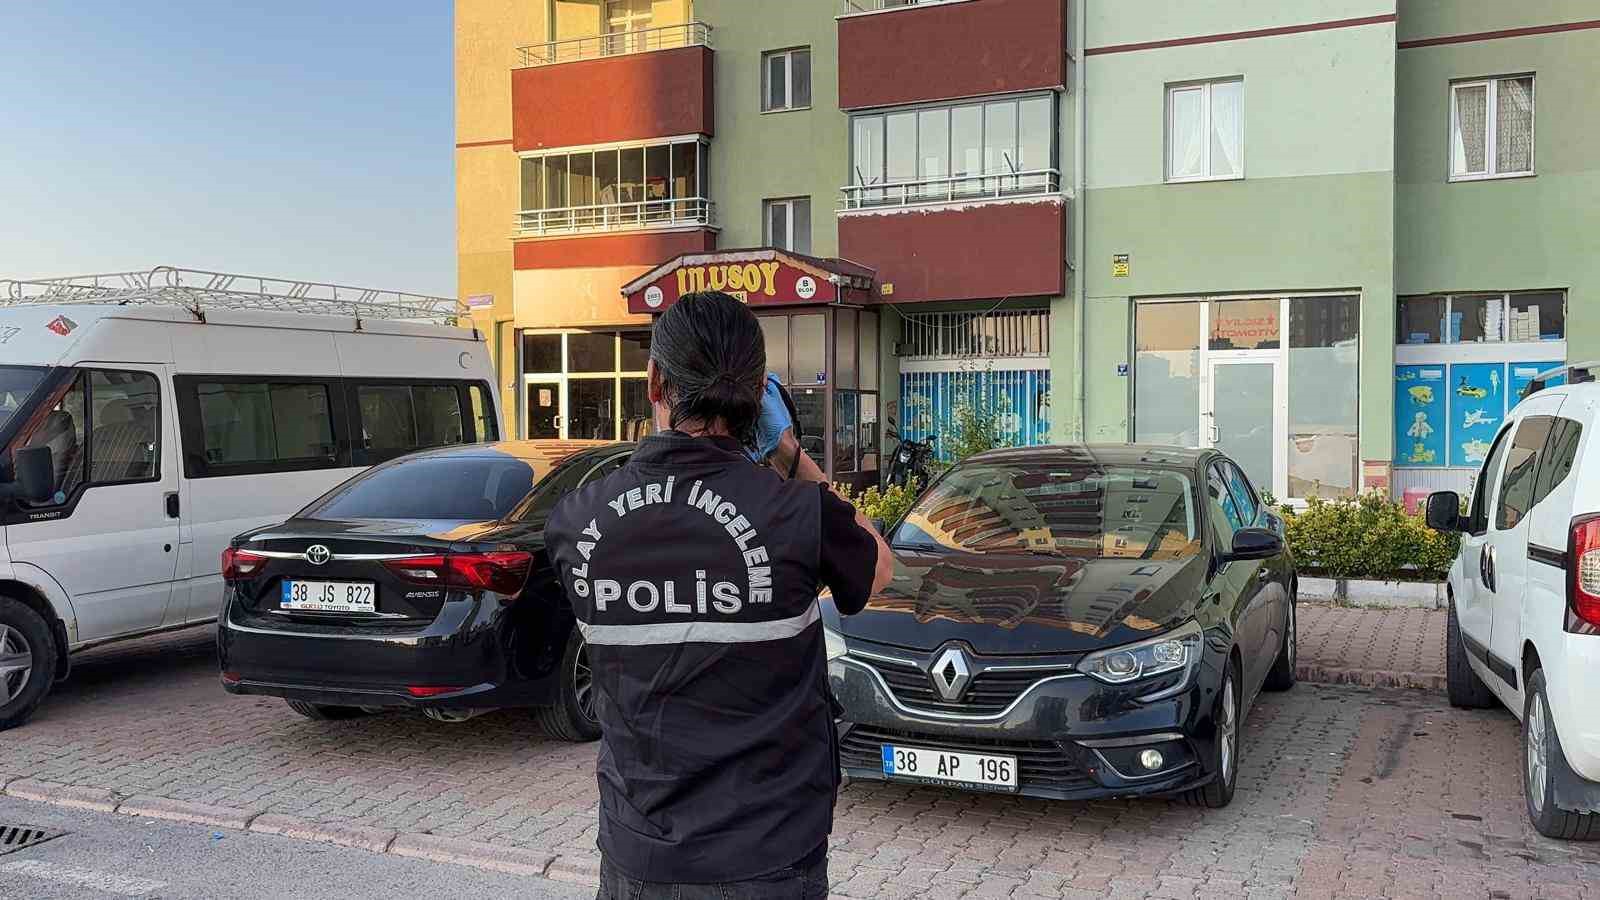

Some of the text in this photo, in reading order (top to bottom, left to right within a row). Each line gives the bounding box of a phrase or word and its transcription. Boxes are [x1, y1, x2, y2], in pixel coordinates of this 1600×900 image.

[30, 511, 61, 520] TRANSIT
[572, 475, 773, 605] OLAY YERİ İNCELEME
[292, 583, 371, 604] 38 JS 822
[593, 569, 743, 615] POLİS
[895, 750, 1010, 782] 38 AP 196
